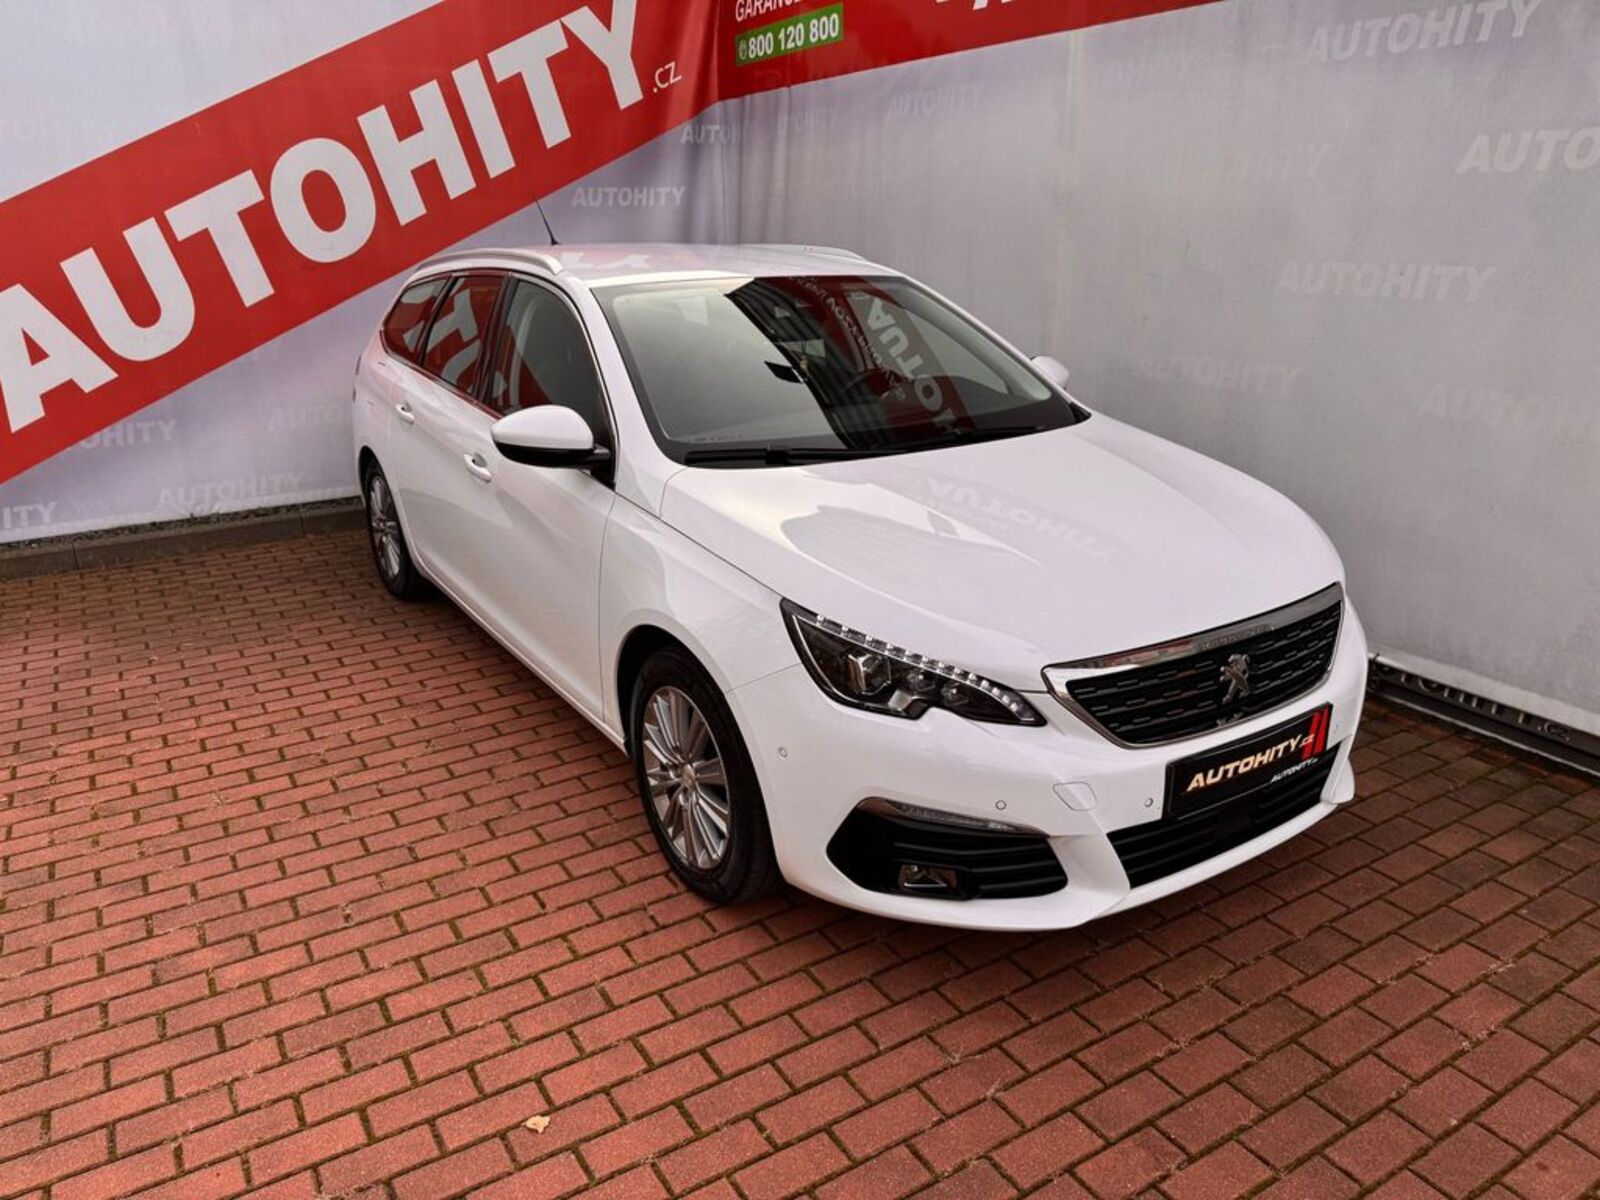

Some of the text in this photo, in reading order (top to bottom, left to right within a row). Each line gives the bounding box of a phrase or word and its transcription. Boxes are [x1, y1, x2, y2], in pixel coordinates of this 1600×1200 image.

[748, 12, 840, 59] 800 120 800
[1307, 0, 1541, 63] AUTOHITY
[571, 186, 686, 208] AUTOHITY
[1275, 260, 1498, 303] AUTOHITY
